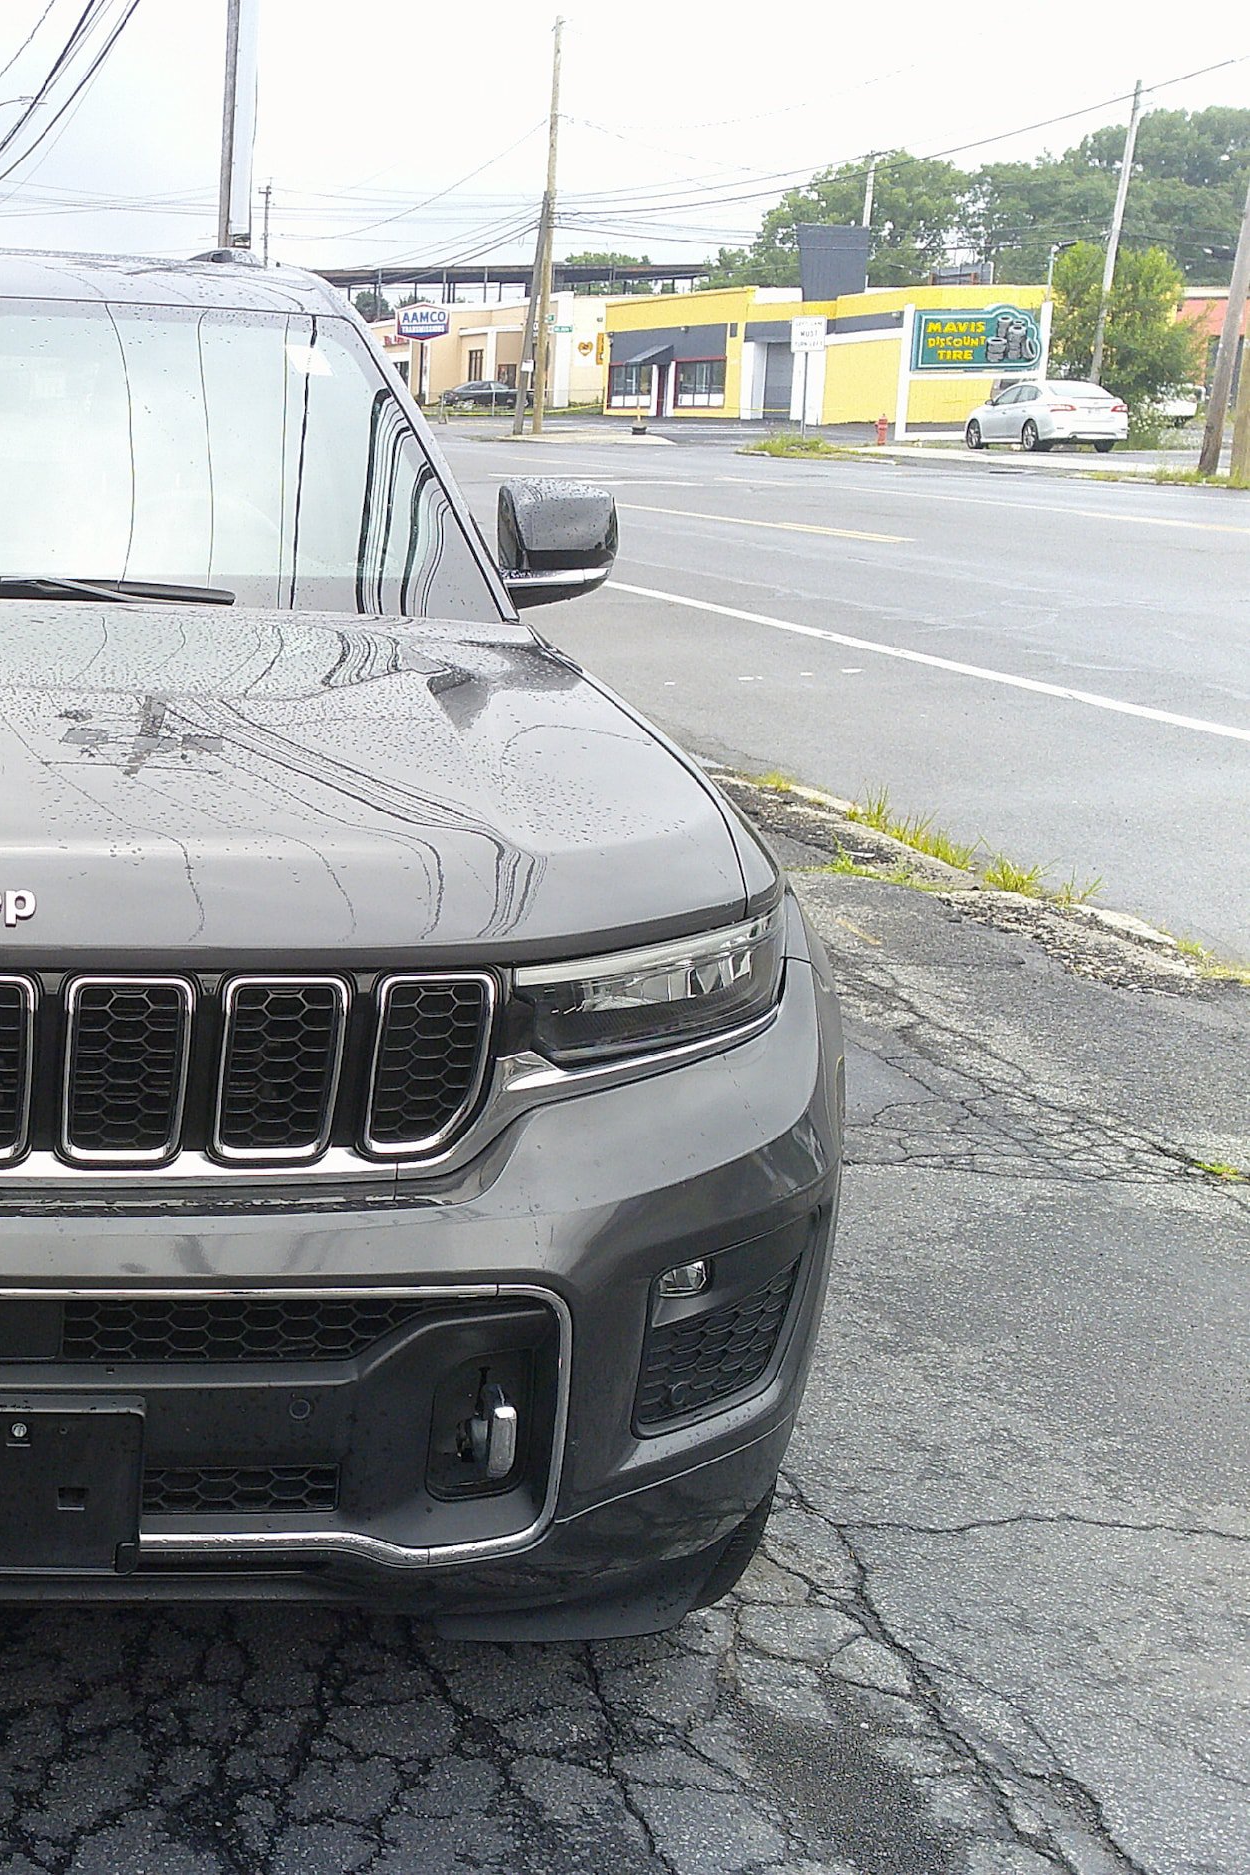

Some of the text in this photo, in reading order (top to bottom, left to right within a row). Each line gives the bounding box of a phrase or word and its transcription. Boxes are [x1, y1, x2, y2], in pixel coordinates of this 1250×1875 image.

[402, 311, 446, 323] AAMCO
[926, 322, 986, 334] MAVIS
[927, 336, 987, 348] DISCOUNT
[937, 350, 974, 361] TIRE
